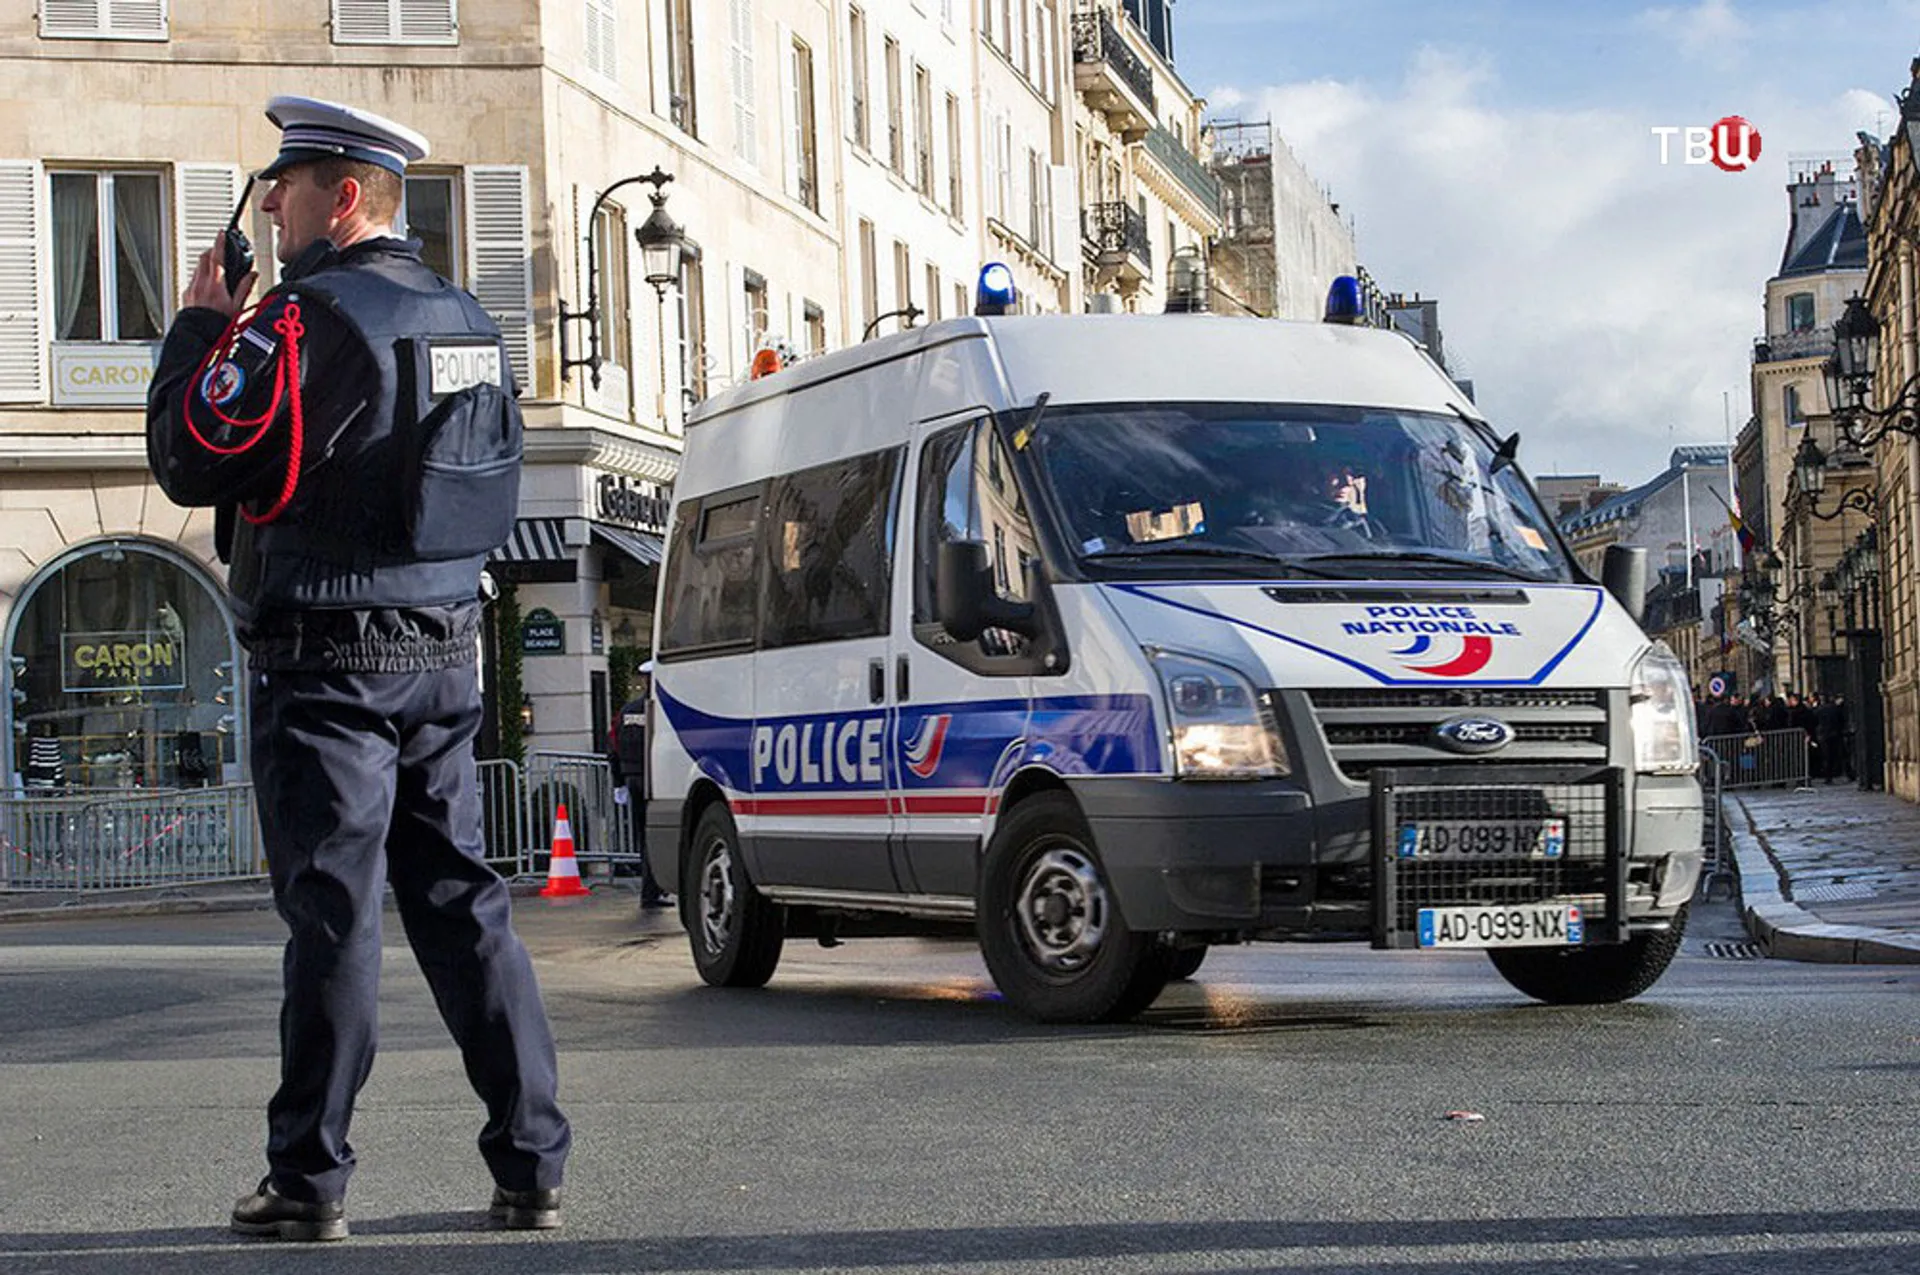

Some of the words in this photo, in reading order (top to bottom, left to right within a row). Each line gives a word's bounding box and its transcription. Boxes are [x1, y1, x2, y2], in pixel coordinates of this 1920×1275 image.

[434, 352, 497, 386] POLICE
[1365, 606, 1476, 619] POLICE
[1341, 621, 1521, 636] NATIONALE
[74, 643, 172, 668] CARON
[1457, 723, 1498, 741] Ford
[754, 717, 884, 785] POLICE
[1439, 910, 1563, 941] AD-099-NX
